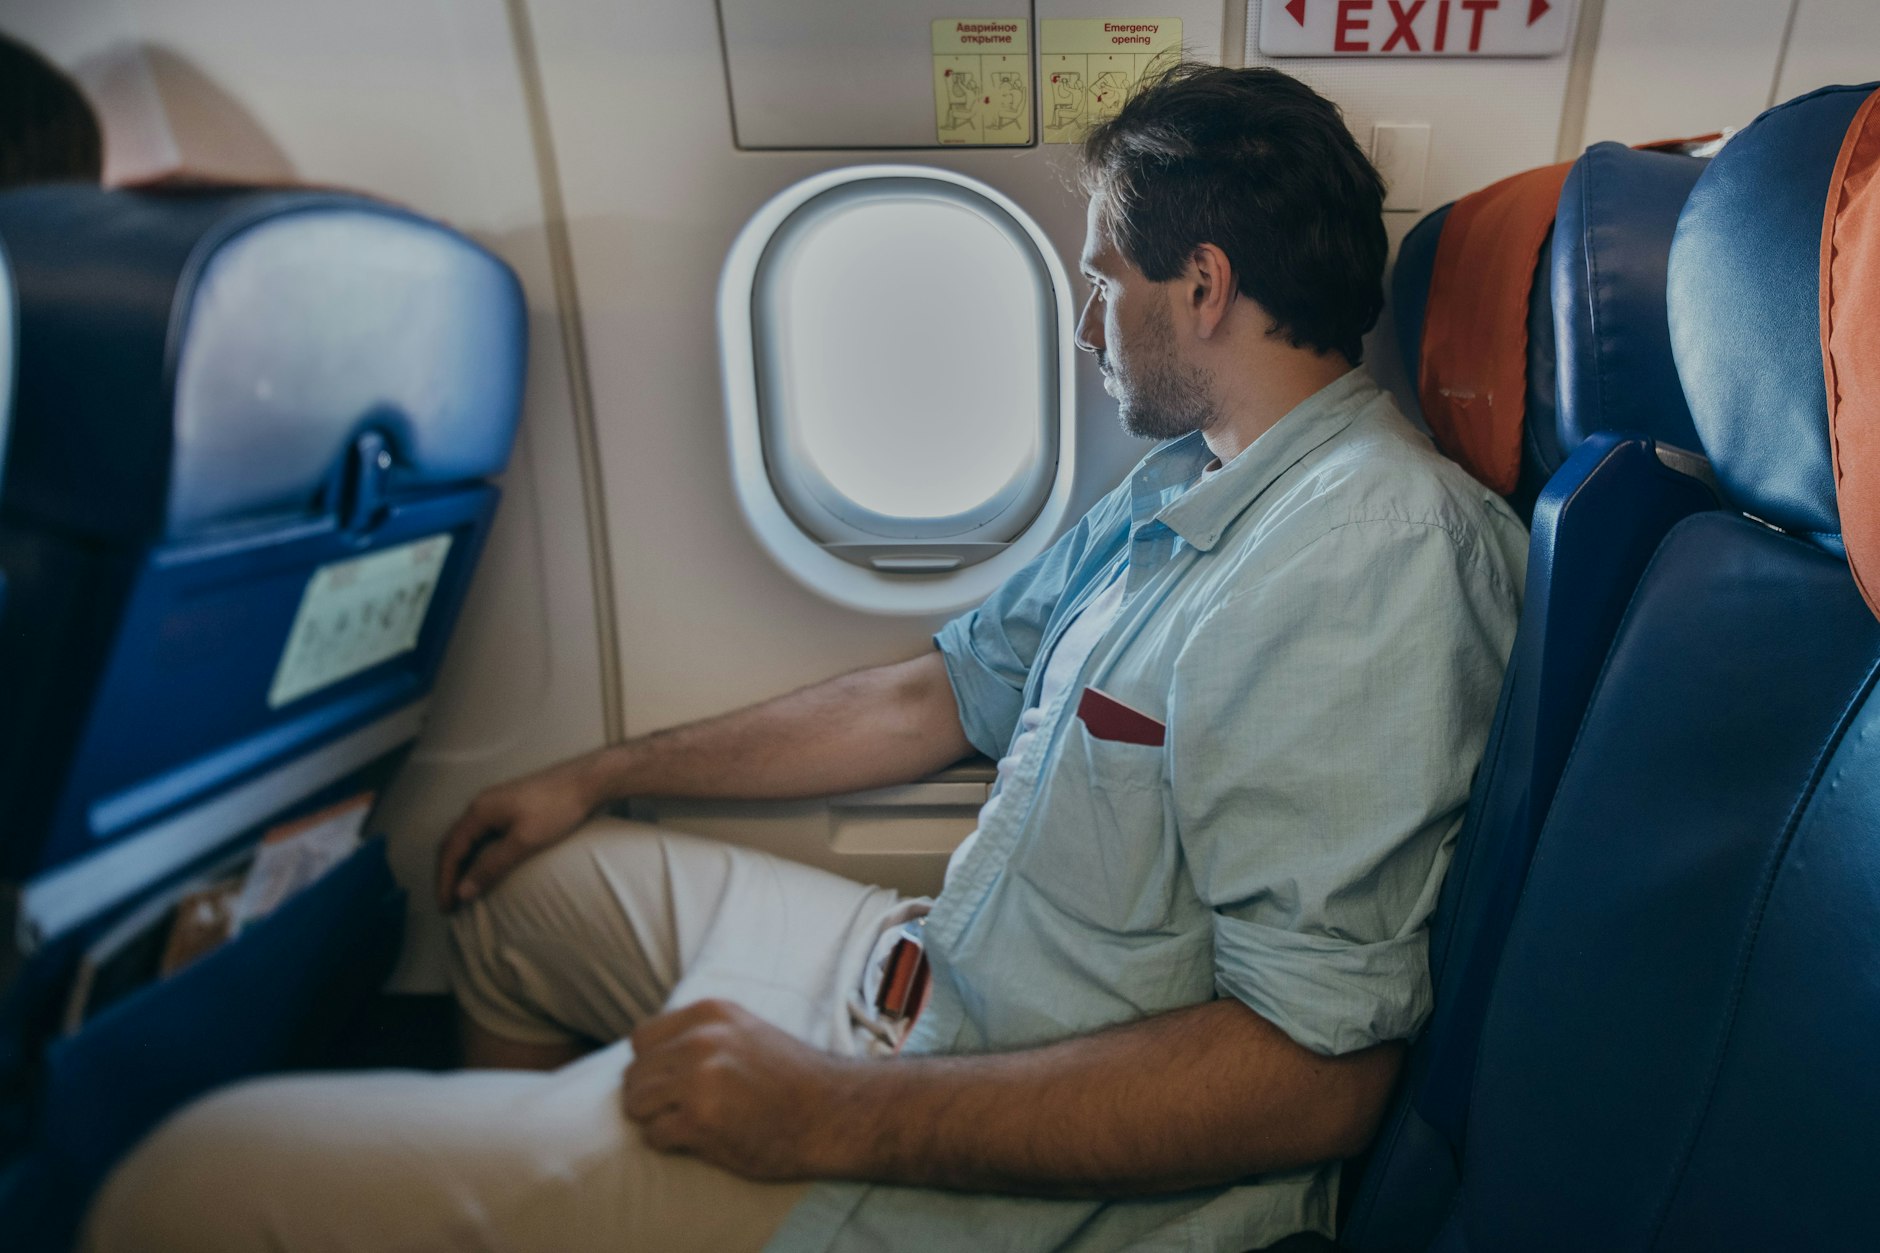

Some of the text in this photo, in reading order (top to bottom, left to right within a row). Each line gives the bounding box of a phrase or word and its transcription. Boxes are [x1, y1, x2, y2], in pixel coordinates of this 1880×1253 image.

[956, 22, 1017, 34] Аварийное
[1104, 23, 1159, 33] Emergency
[1333, 0, 1498, 52] EXIT
[961, 35, 1012, 45] открытие
[1111, 34, 1151, 45] opening
